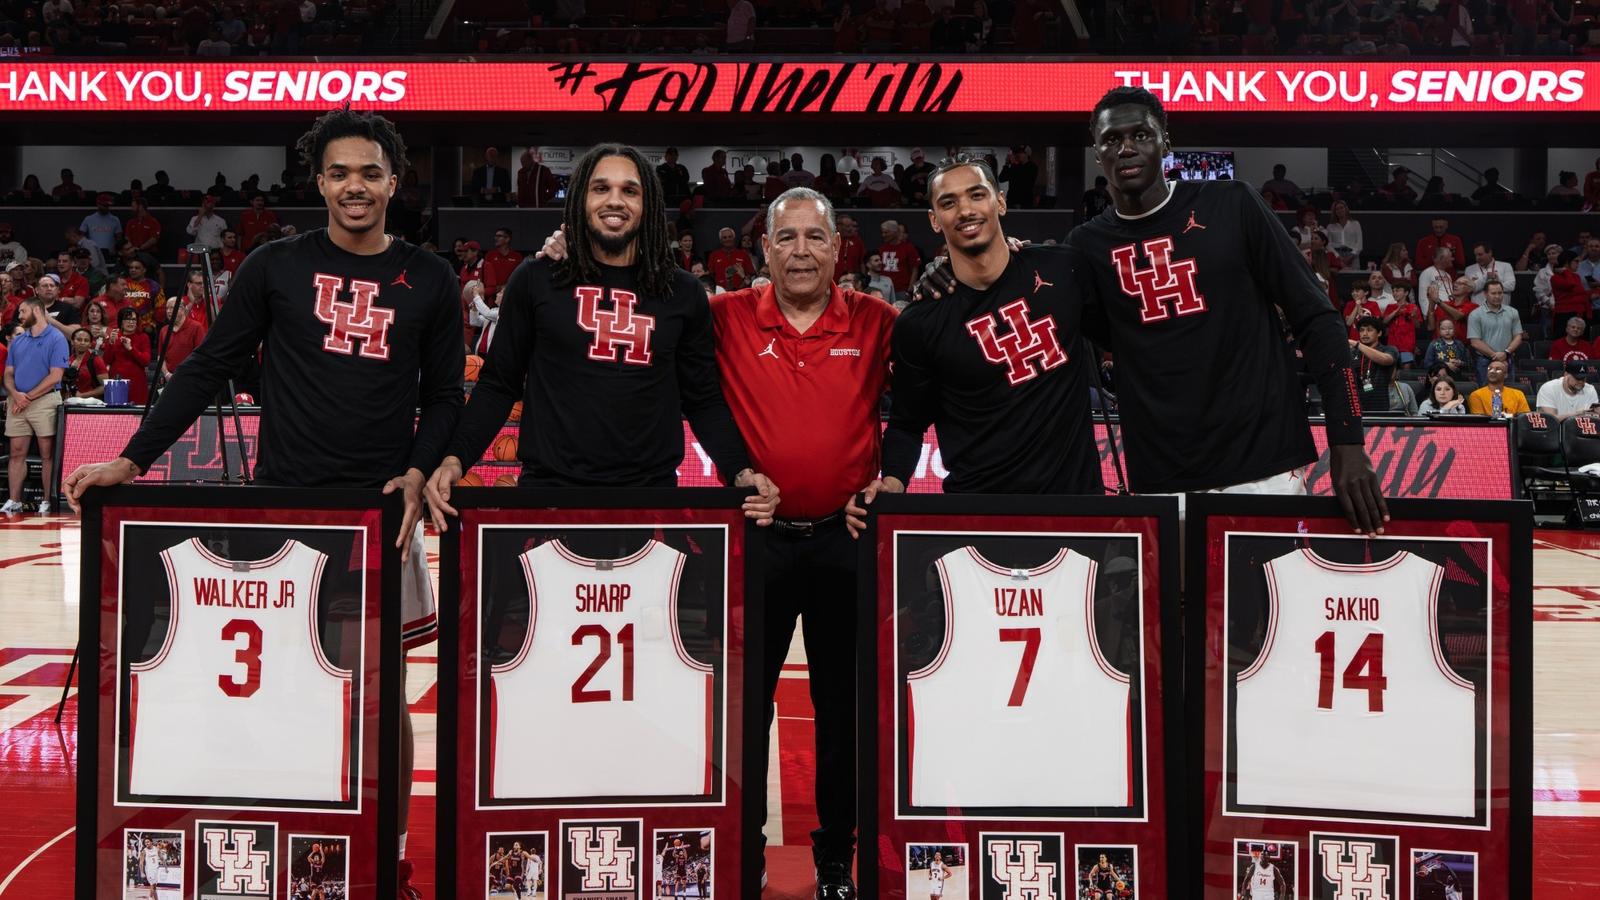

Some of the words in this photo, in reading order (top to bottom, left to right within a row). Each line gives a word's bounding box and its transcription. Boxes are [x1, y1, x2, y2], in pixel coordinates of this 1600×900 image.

[115, 70, 213, 107] YOU,
[222, 70, 408, 102] SENIORS
[1114, 70, 1267, 102] THANK
[1276, 70, 1379, 107] YOU,
[1388, 70, 1585, 102] SENIORS
[124, 290, 150, 299] ouston
[1111, 235, 1208, 324] UH
[313, 272, 395, 361] UH
[574, 285, 656, 366] UH
[965, 297, 1069, 386] UH
[193, 577, 267, 609] WALKER
[273, 580, 295, 608] JR
[575, 583, 631, 613] SHARP
[994, 587, 1044, 617] UZAN
[1325, 597, 1380, 622] SAKHO
[218, 618, 263, 698] 3
[571, 623, 634, 704] 21
[999, 627, 1041, 707] 7
[1314, 630, 1388, 713] 14
[203, 827, 270, 894] UH
[567, 826, 636, 892] UH
[987, 839, 1057, 900] UH
[1318, 839, 1390, 900] UH
